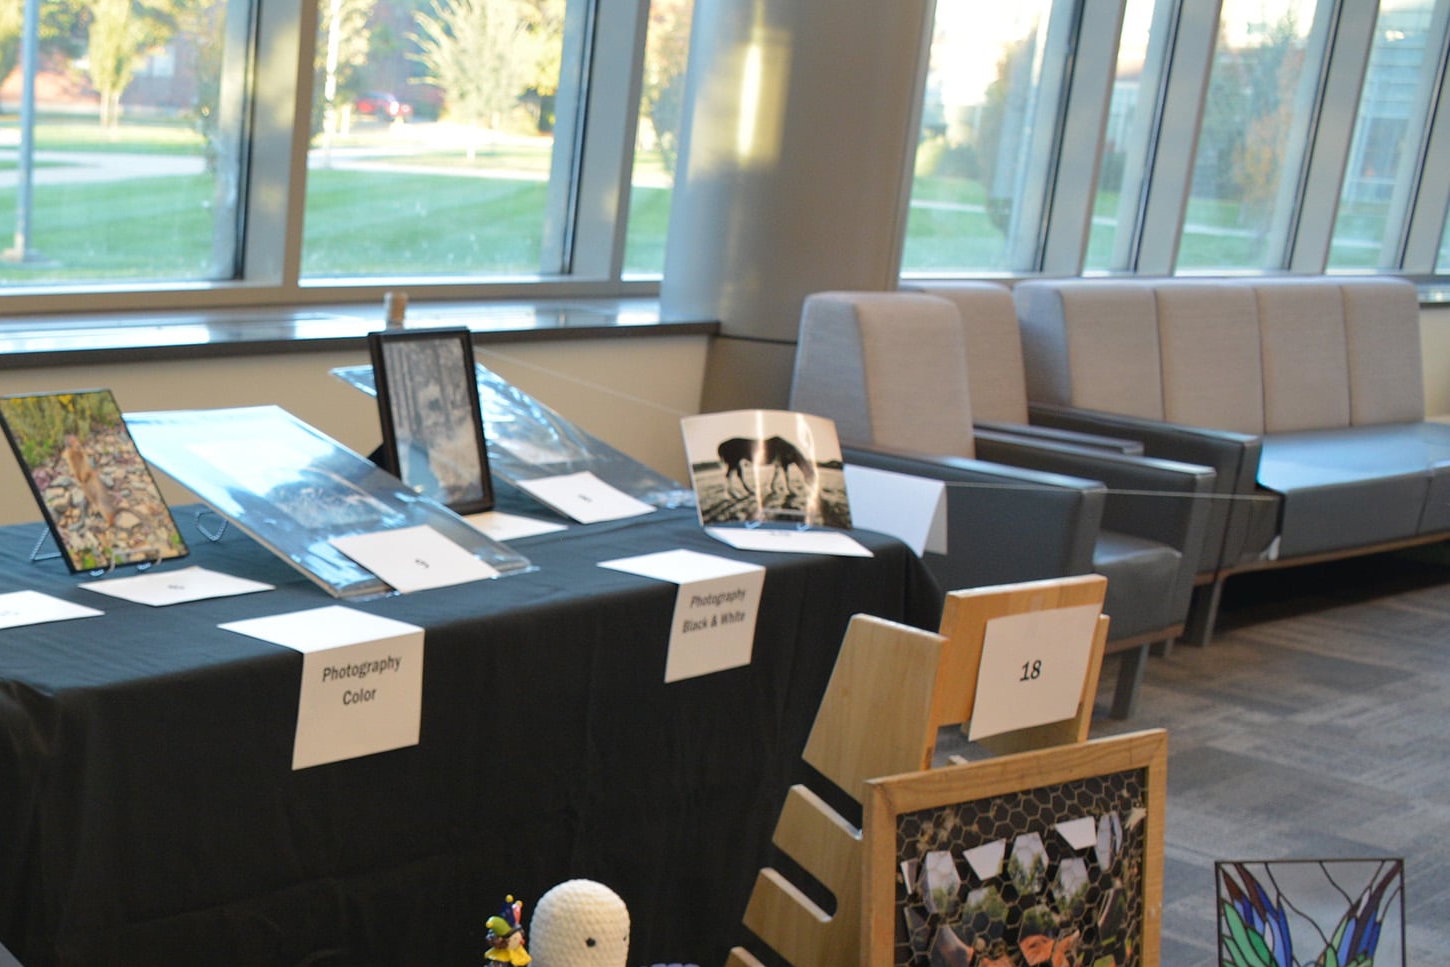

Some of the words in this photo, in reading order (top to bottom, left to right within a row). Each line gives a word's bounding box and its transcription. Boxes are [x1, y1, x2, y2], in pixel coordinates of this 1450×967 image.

[690, 588, 747, 608] Photography
[682, 618, 708, 634] Black
[720, 611, 746, 625] White
[322, 656, 402, 682] Photography
[1019, 660, 1042, 682] 18
[342, 688, 377, 706] Color
